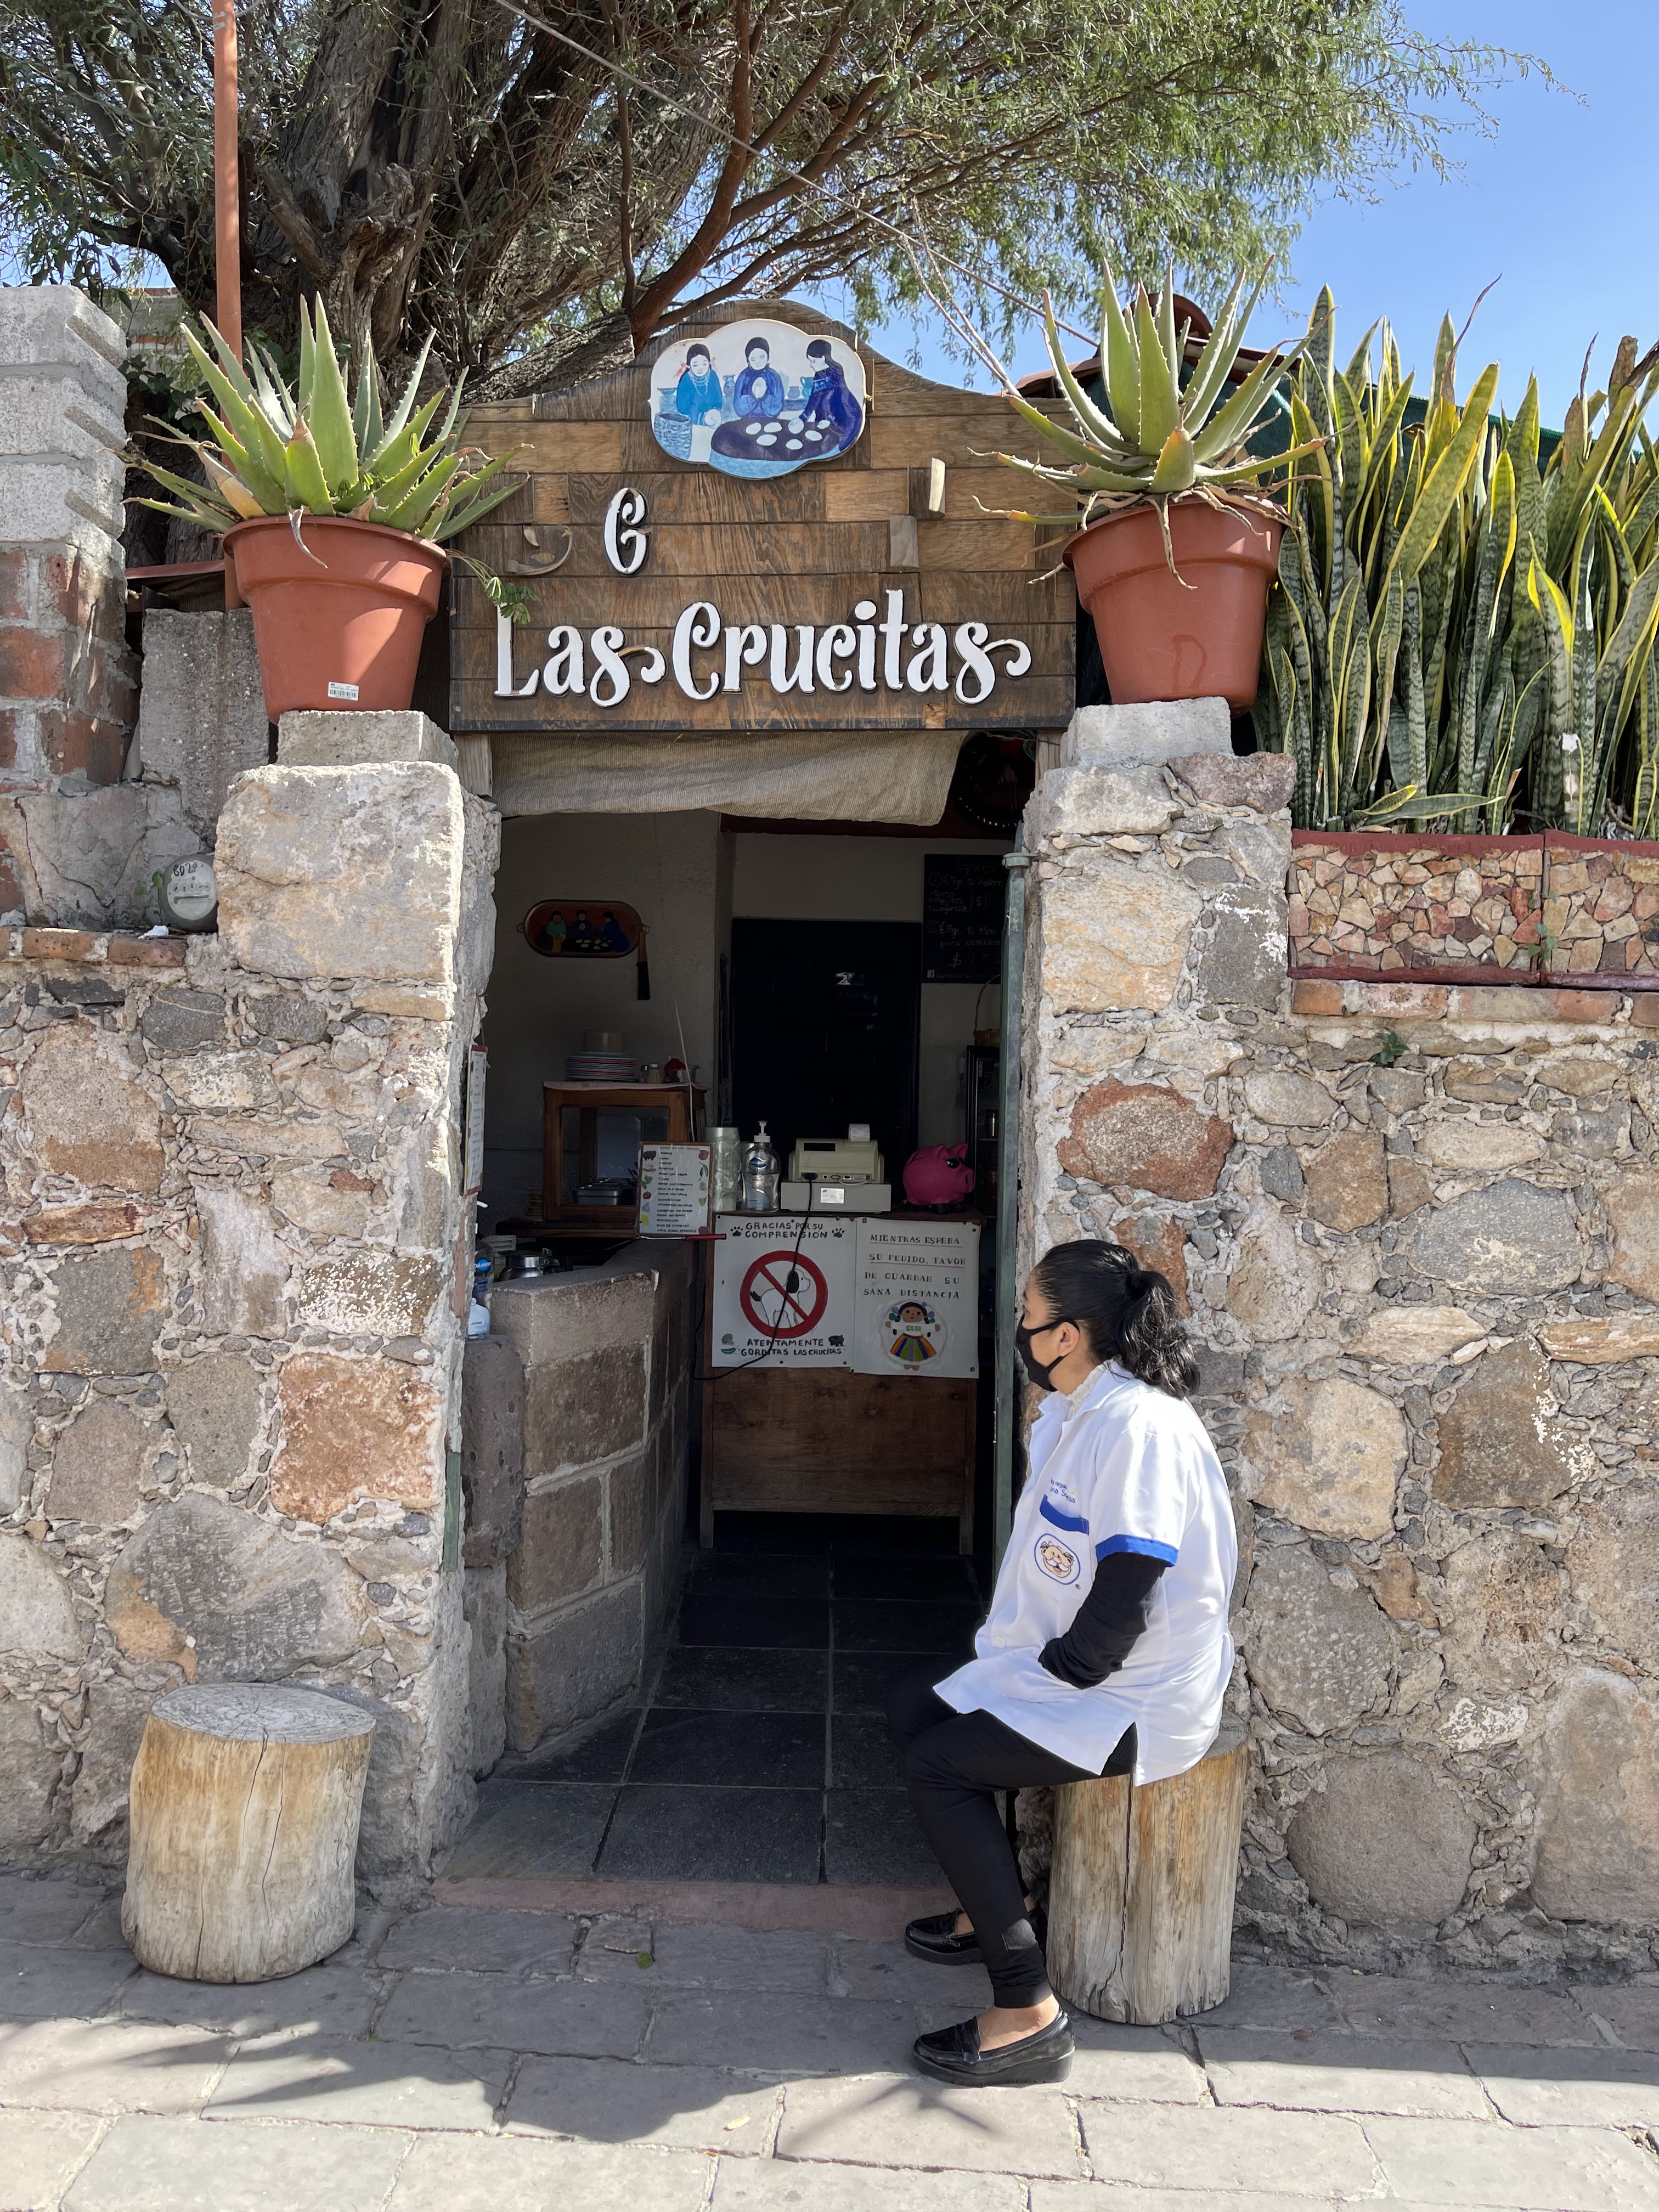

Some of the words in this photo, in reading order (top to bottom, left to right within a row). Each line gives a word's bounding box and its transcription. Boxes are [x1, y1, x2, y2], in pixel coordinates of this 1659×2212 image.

[493, 602, 667, 708] Las
[672, 588, 1032, 706] Crucitas
[940, 940, 960, 949] para
[966, 938, 1002, 946] combina
[746, 1222, 791, 1230] GRACIAS
[745, 1230, 828, 1238] COMPRENSIÓN
[870, 1234, 921, 1243] MIENTRAS
[924, 1236, 960, 1244] ESPERA
[889, 1254, 929, 1265] PEDIDO,
[934, 1257, 966, 1265] FAVOR
[885, 1272, 933, 1283] GUARDAR
[900, 1289, 960, 1299] DISTANCIA
[747, 1338, 823, 1346] ATENTAMENTE
